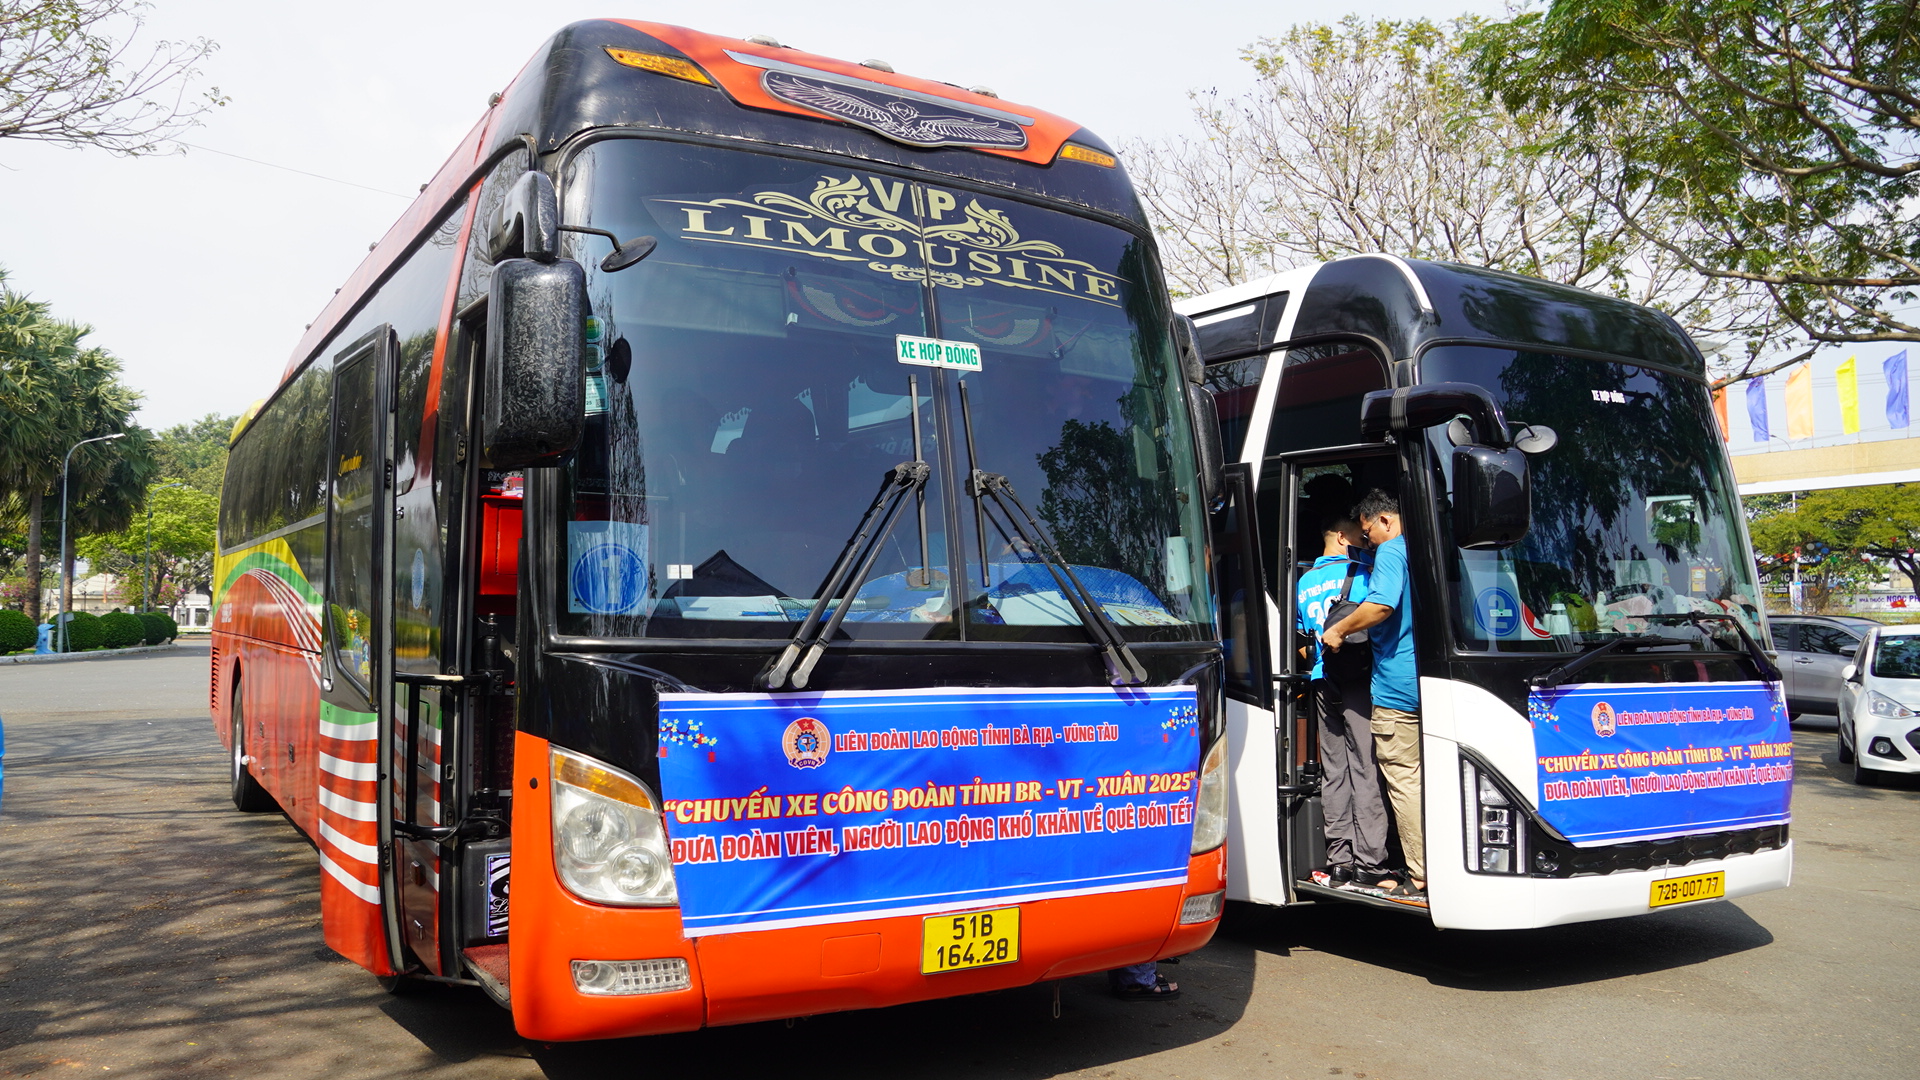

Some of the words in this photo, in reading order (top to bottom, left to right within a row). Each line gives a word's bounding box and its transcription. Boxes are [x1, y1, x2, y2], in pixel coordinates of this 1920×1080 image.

[868, 177, 956, 220] VIP
[681, 207, 1120, 301] LIMOUSINE
[900, 340, 916, 359] XE
[919, 342, 942, 364] HỢP
[945, 344, 978, 366] ĐỒNG
[1616, 711, 1634, 726] LIÊN
[1634, 710, 1654, 725] ĐOÀN
[1655, 711, 1668, 724] LAO
[1669, 708, 1687, 726] ĐỘNG
[1687, 707, 1701, 722] TỈNH
[1702, 707, 1711, 721] BÀ
[1712, 709, 1723, 724] RỊA
[1726, 707, 1742, 720] VŨNG
[1743, 706, 1754, 720] TÀU
[835, 731, 868, 751] LIÊN
[871, 729, 908, 750] ĐOÀN
[913, 731, 939, 749] LAO
[942, 727, 978, 750] ĐỘNG
[980, 724, 1011, 746] TỈNH
[1013, 726, 1031, 745] BÀ
[1033, 728, 1054, 747] RỊA
[1063, 724, 1095, 743] VŨNG
[1097, 722, 1119, 741] TÀU
[1600, 754, 1618, 769] XE
[1618, 748, 1649, 768] CÔNG
[1651, 747, 1683, 766] ĐOÀN
[1683, 745, 1708, 764] TỈNH
[1709, 747, 1724, 762] BR
[1730, 746, 1743, 760] VT
[1748, 740, 1774, 759] XUÂN
[664, 786, 781, 823] “CHUYẾN
[785, 794, 817, 817] XE
[822, 785, 888, 814] CÔNG
[892, 781, 955, 810] ĐOÀN
[959, 777, 1010, 805] TỈNH
[1015, 781, 1042, 801] BR
[1057, 778, 1083, 799] VT
[1096, 770, 1146, 797] XUÂN
[1544, 780, 1571, 801] ĐƯA
[1571, 777, 1602, 800] ĐOÀN
[1602, 775, 1630, 797] VIÊN,
[1630, 772, 1661, 795] NGƯỜI
[1663, 773, 1681, 792] LAO
[1682, 770, 1706, 793] ĐỘNG
[1757, 763, 1771, 785] QUÊ
[671, 837, 717, 865] ĐƯA
[721, 829, 782, 863] ĐOÀN
[785, 825, 839, 856] VIÊN,
[843, 819, 902, 852] NGƯỜI
[907, 821, 942, 846] LAO
[945, 814, 995, 847] ĐỘNG
[998, 810, 1032, 840] KHÓ
[1035, 807, 1080, 836] KHĂN
[1083, 804, 1103, 832] VỀ
[1106, 803, 1135, 833] QUÊ
[1138, 799, 1167, 828] ĐÓN
[1169, 797, 1193, 825] TẾT
[953, 914, 993, 940] 51B
[937, 938, 1008, 968] 164.28
